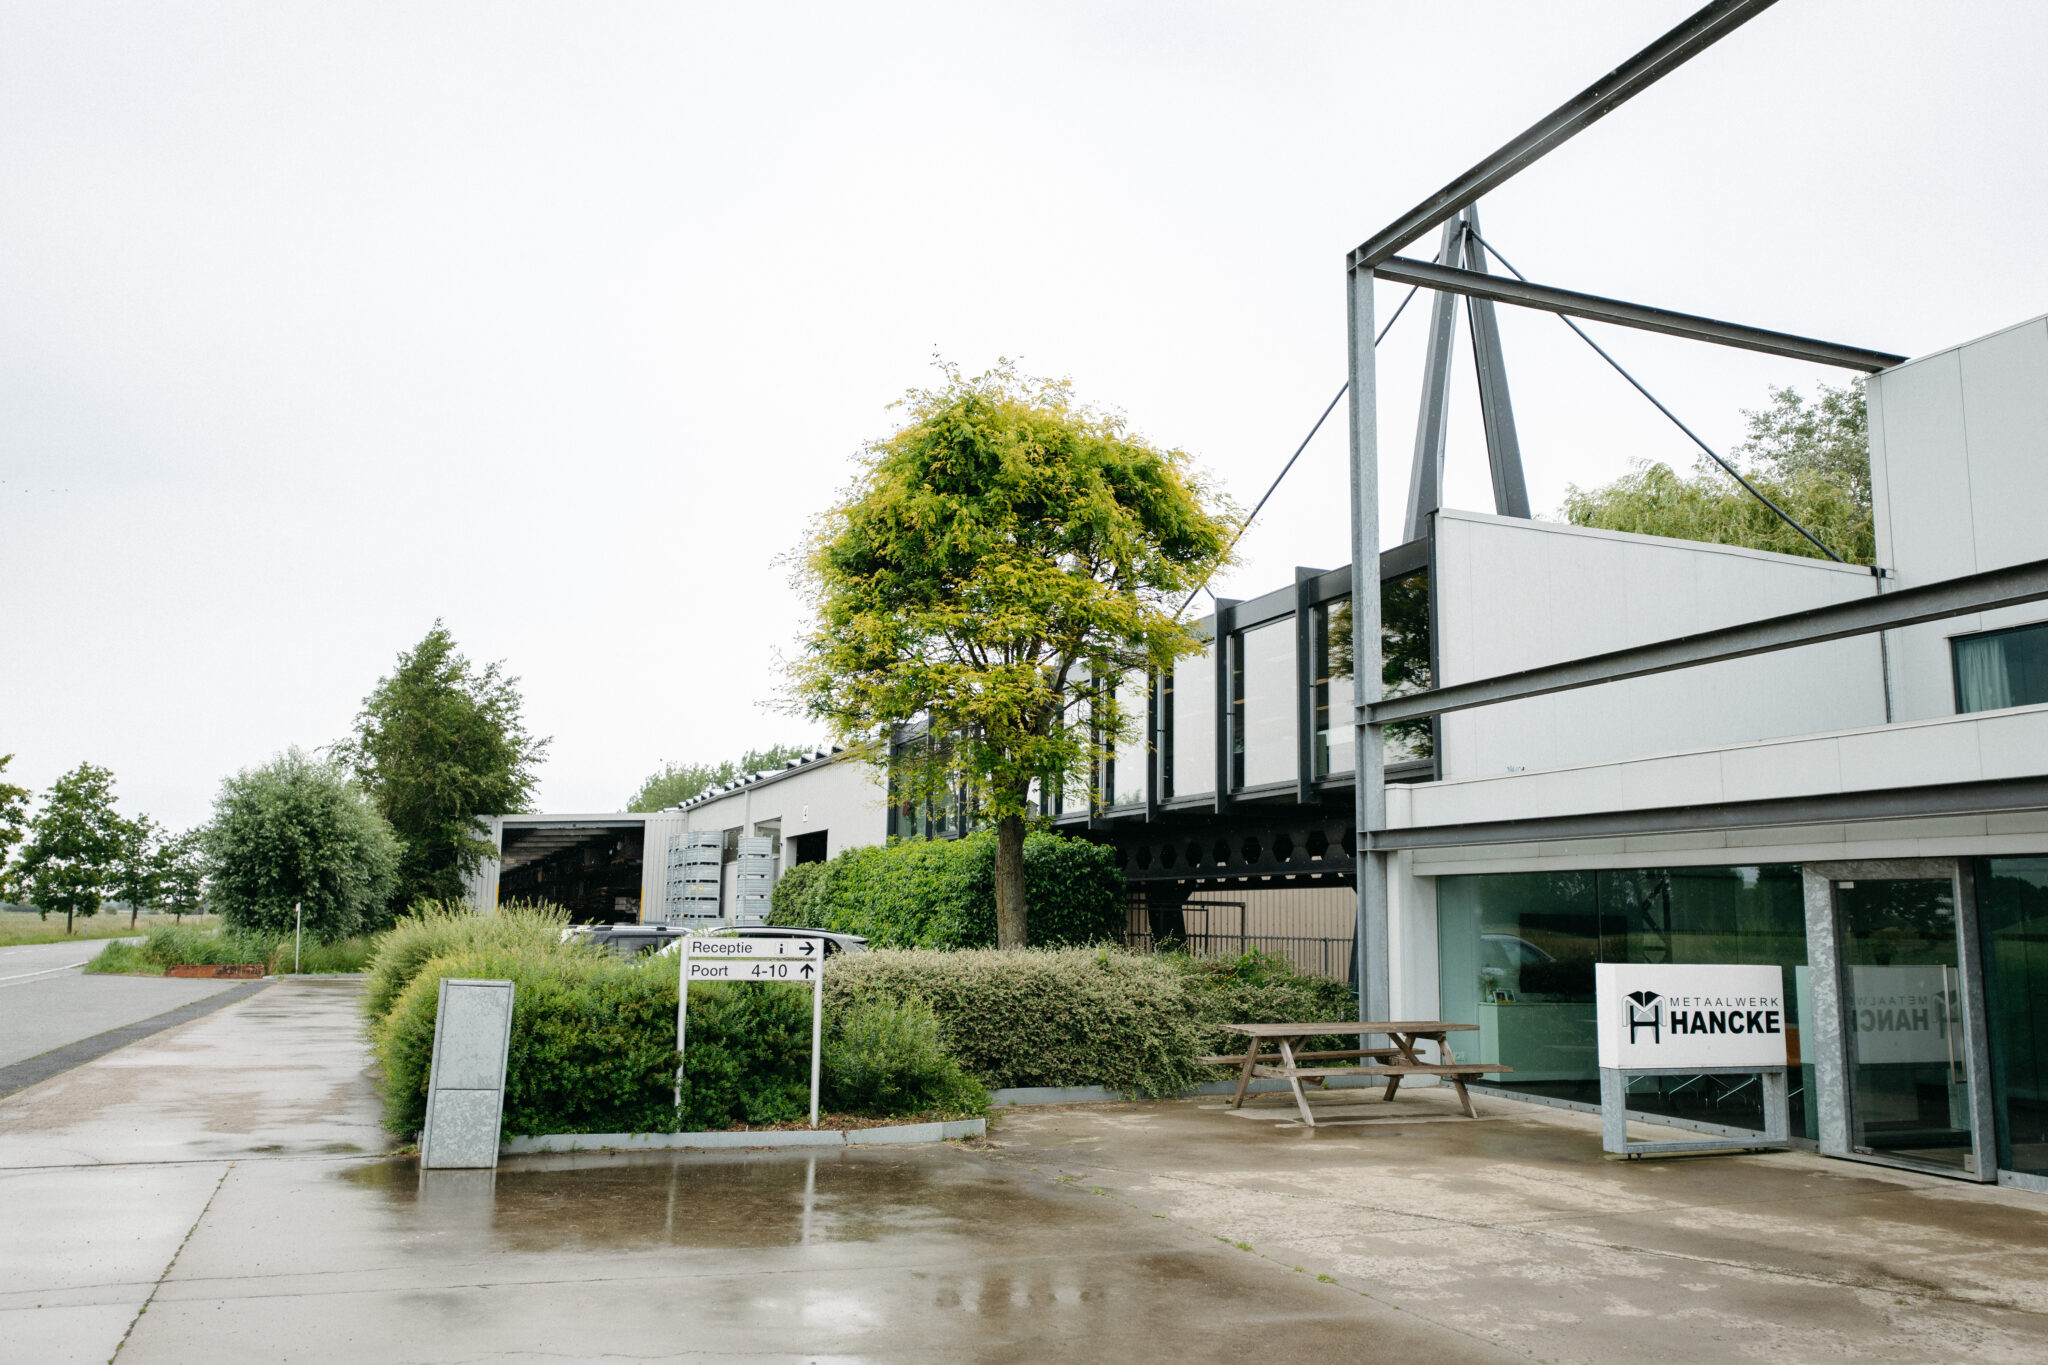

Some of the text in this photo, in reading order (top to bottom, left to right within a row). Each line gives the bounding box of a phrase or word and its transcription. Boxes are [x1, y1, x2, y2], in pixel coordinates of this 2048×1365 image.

[692, 941, 753, 954] Receptie
[691, 964, 788, 978] Poort 4-10
[1670, 997, 1779, 1007] METAALWERK
[1671, 1010, 1781, 1034] HANCKE
